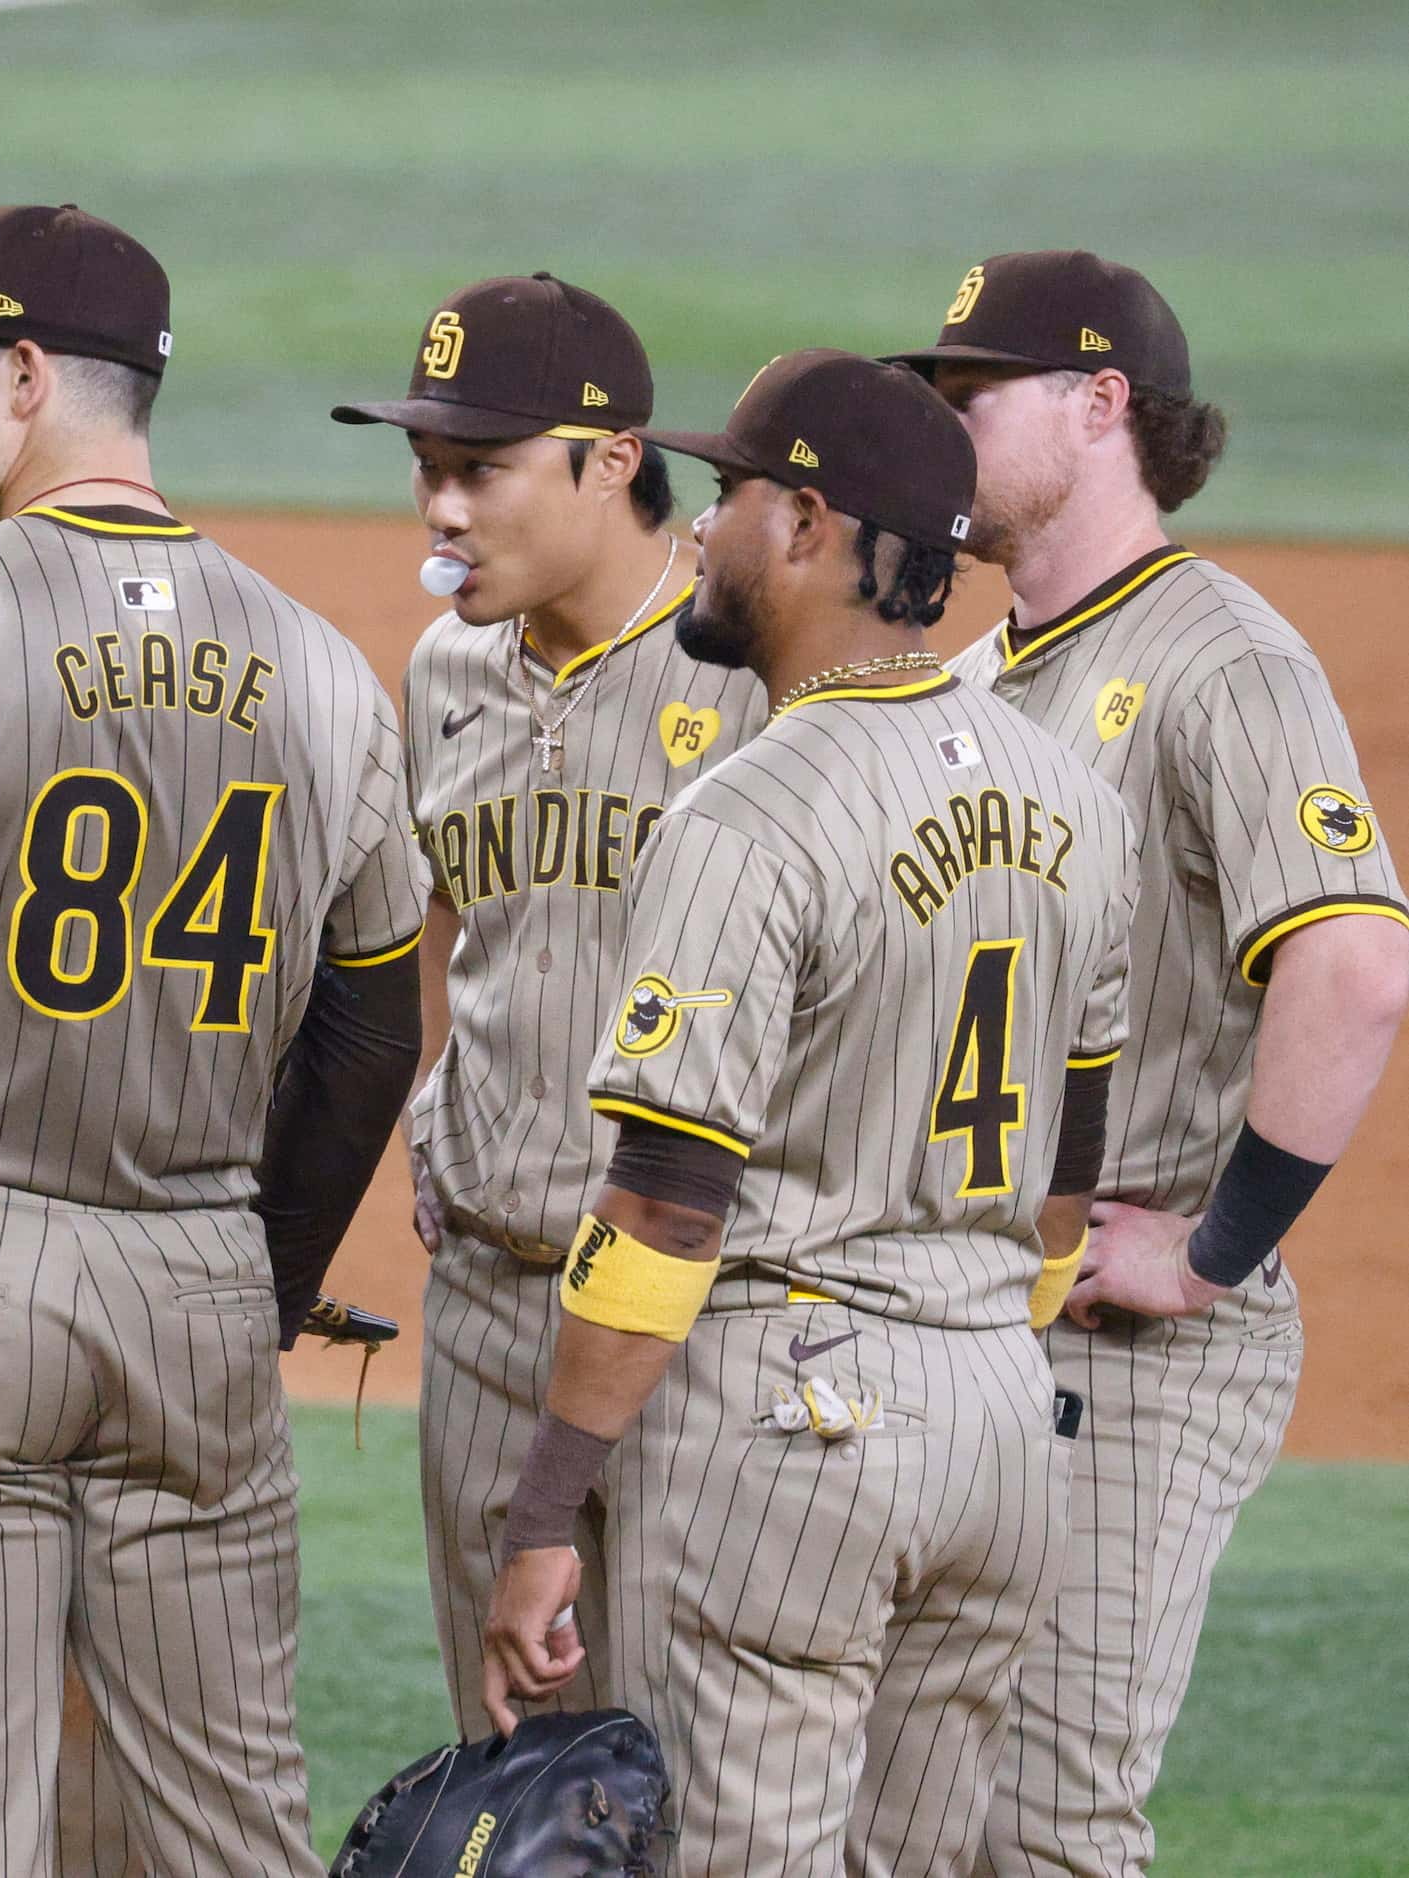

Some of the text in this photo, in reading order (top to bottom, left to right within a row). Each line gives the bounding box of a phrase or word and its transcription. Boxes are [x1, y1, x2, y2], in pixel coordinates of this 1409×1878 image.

[422, 311, 465, 380] SD
[54, 631, 276, 735] CEASE
[669, 716, 705, 752] PS
[1102, 691, 1135, 727] PS
[6, 767, 288, 1034] 84
[428, 794, 521, 915] AN
[890, 786, 1075, 929] ARRAEZ
[927, 936, 1026, 1199] 4
